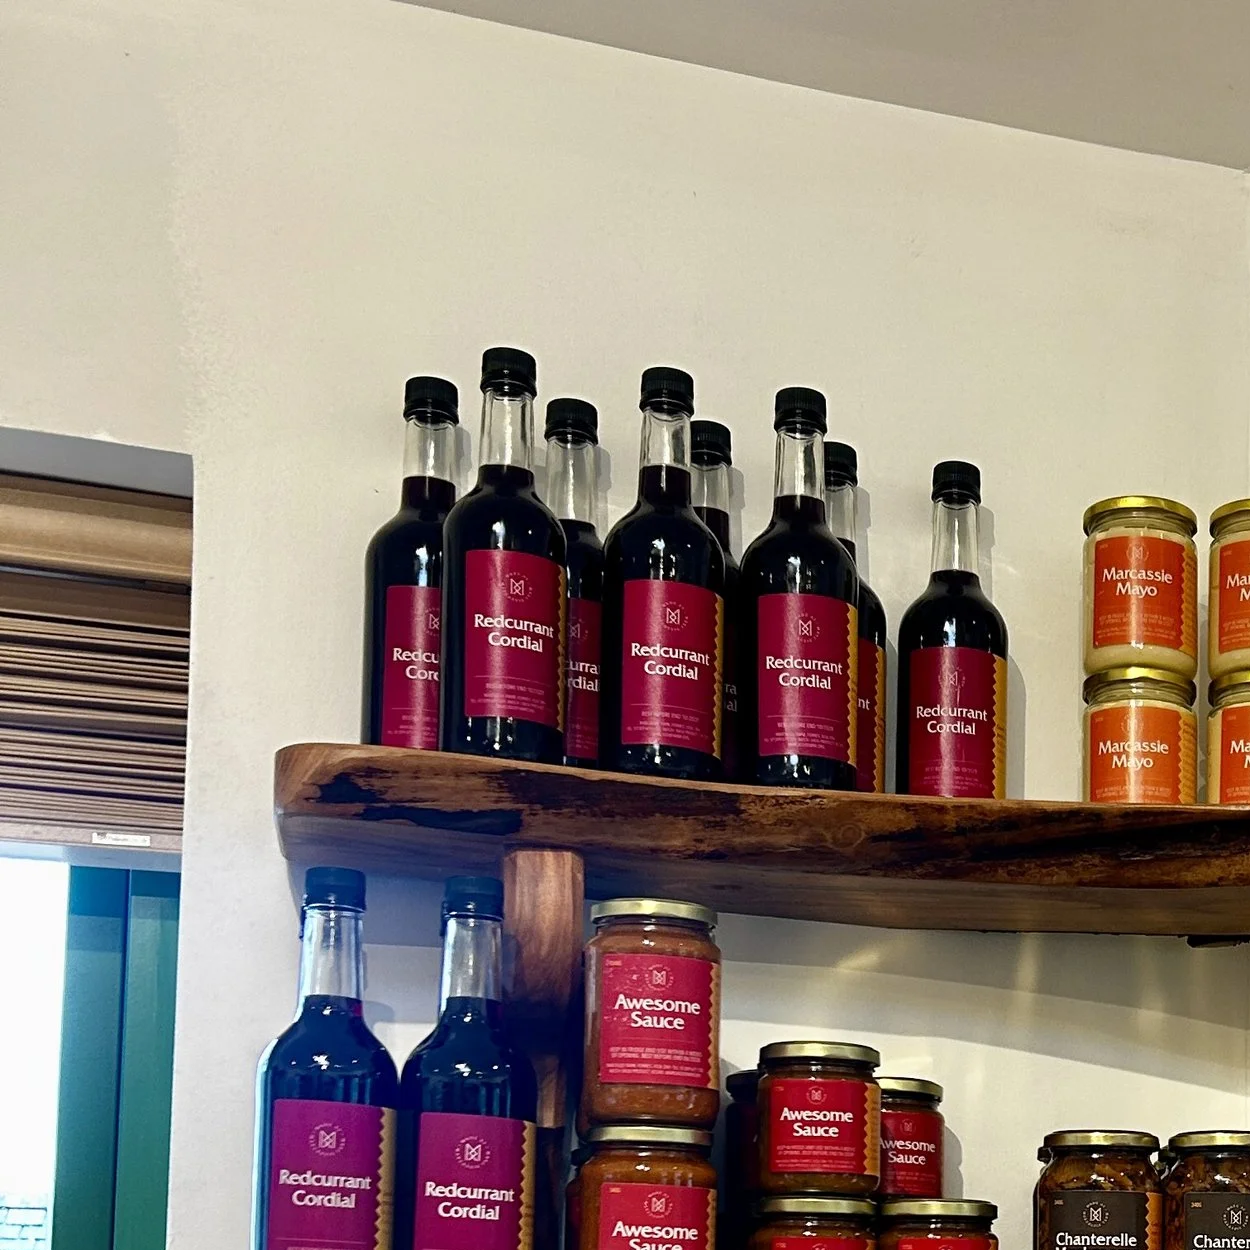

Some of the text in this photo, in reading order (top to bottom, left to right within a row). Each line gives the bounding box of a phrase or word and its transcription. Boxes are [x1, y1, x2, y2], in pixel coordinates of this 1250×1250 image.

[1102, 567, 1173, 584] Marcassie
[1116, 582, 1158, 597] Mayo
[474, 614, 554, 638] Redcurrant
[488, 632, 543, 652] Cordial
[393, 648, 439, 662] Redcu
[631, 643, 709, 666] Redcurrant
[644, 660, 698, 680] Cordial
[766, 656, 842, 675] Redcurrant
[779, 673, 831, 689] Cordial
[916, 704, 987, 721] Redcurrant
[927, 721, 976, 735] Cordial
[1098, 740, 1168, 755] Marcassie
[1112, 754, 1153, 769] Mayo
[615, 994, 700, 1015] Awesome
[631, 1012, 685, 1029] Sauce
[780, 1107, 853, 1123] Awesome
[793, 1123, 838, 1138] Sauce
[879, 1137, 935, 1152] Awesome
[888, 1151, 926, 1165] Sauce
[279, 1170, 372, 1190] Redcurrant
[292, 1190, 355, 1208] Cordial
[425, 1182, 514, 1202] Redcurrant
[438, 1202, 499, 1220] Cordial
[612, 1221, 698, 1240] Awesome
[1056, 1232, 1137, 1246] Chanterelle
